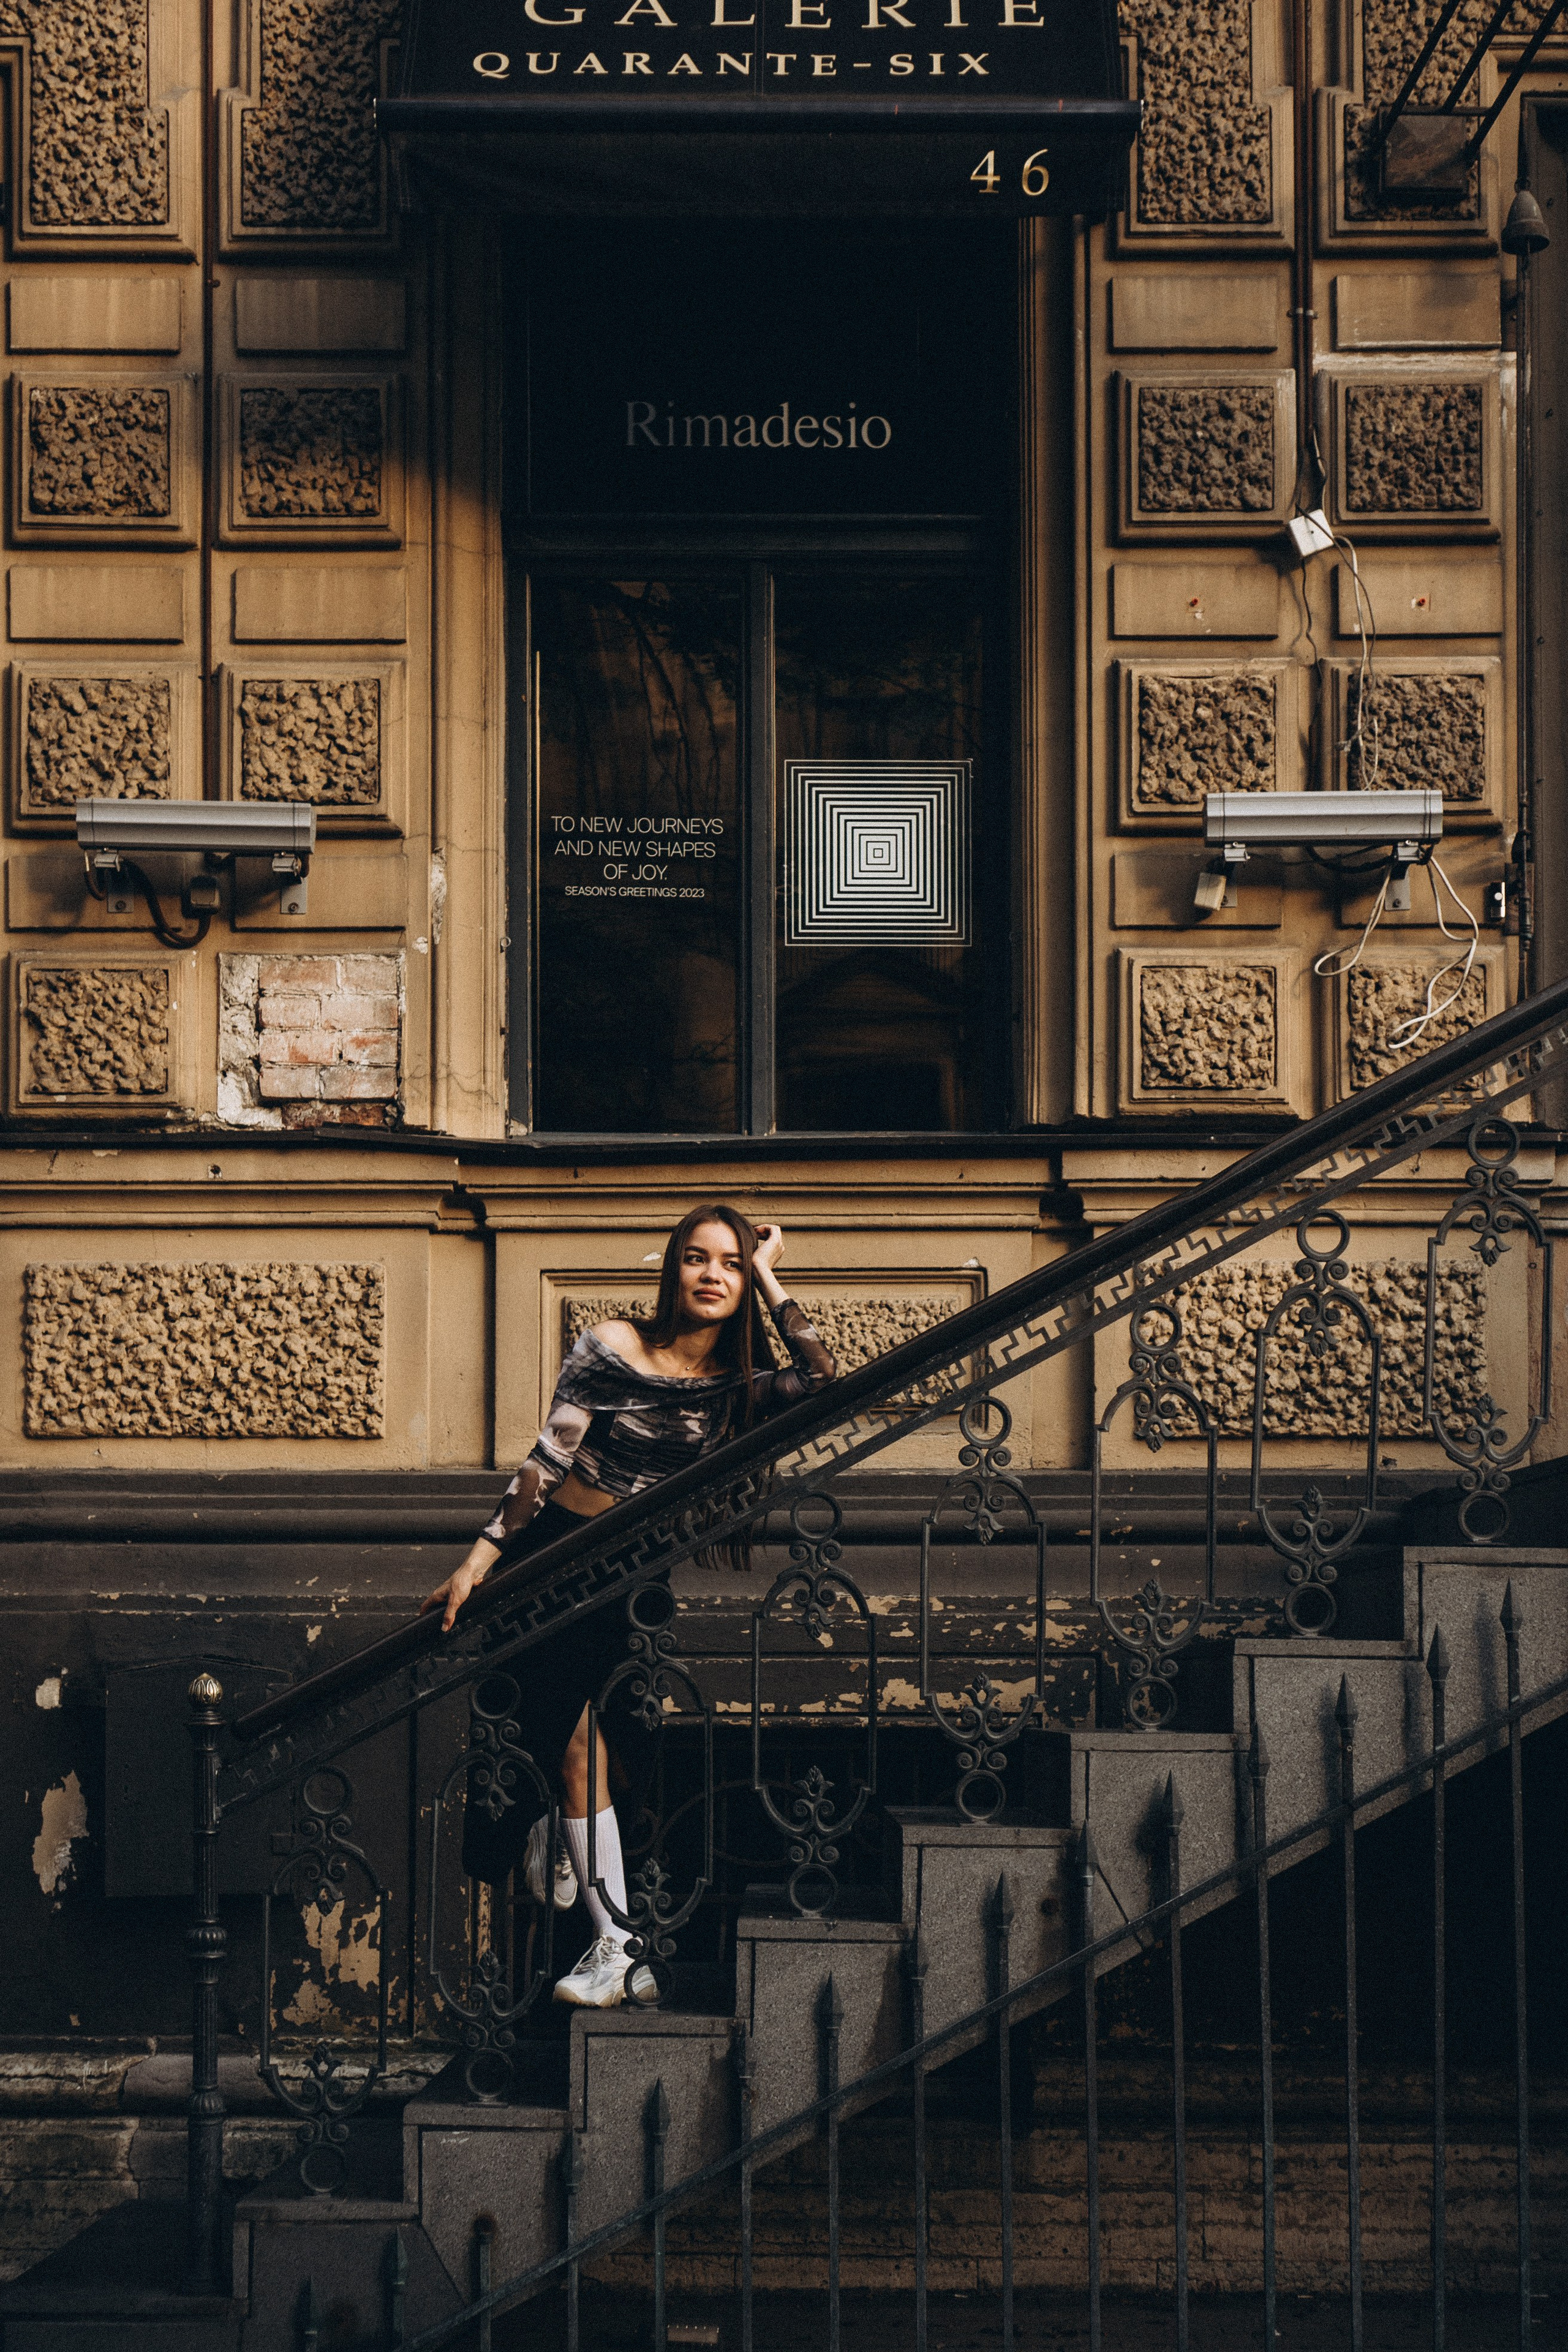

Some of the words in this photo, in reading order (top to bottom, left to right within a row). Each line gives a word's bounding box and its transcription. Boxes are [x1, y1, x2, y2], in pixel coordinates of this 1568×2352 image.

[524, 0, 1045, 29] GALERIE
[472, 52, 990, 79] QUARANTE-SIX
[624, 400, 892, 450] Rimadesio
[551, 816, 575, 832] TO
[581, 816, 623, 833] NEW
[627, 817, 724, 835] JOURNEYS
[554, 840, 594, 856] AND
[598, 840, 641, 857] NEW
[646, 840, 716, 858] SHAPES
[603, 863, 628, 880] OF
[631, 864, 668, 881] JOY.
[618, 886, 677, 898] GREETINGS
[679, 888, 705, 899] 2023
